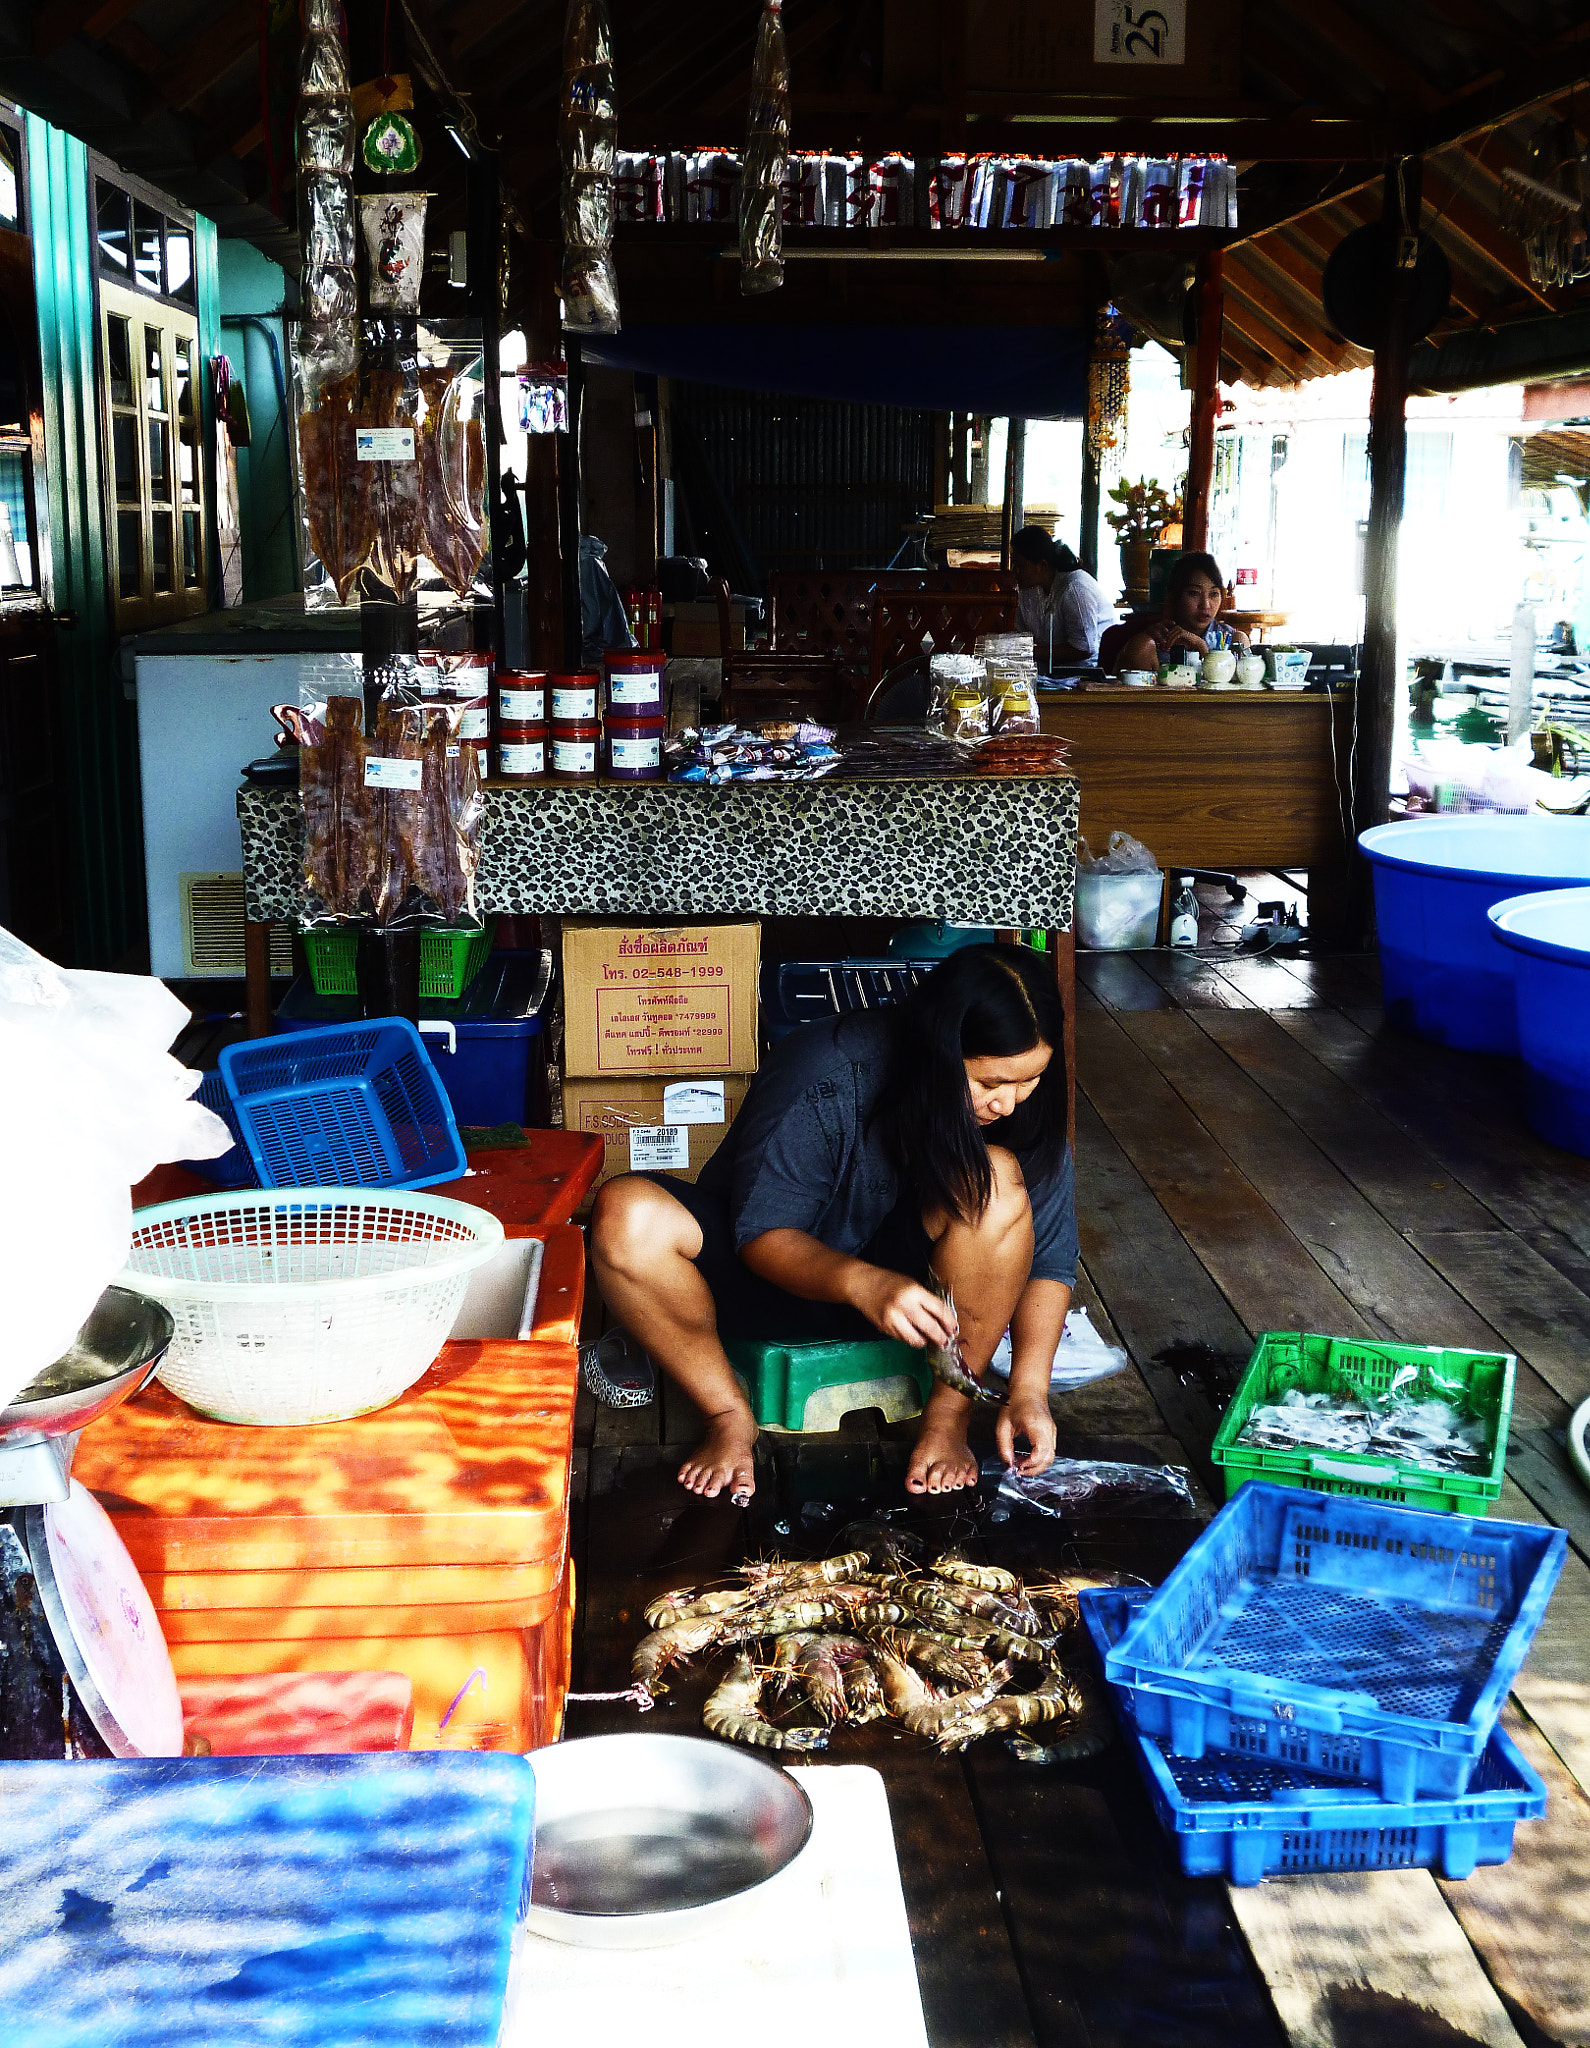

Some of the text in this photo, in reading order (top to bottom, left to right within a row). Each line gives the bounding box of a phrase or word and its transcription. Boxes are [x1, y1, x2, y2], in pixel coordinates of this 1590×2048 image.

[1124, 5, 1169, 58] 25
[618, 935, 709, 955] สั่งซื้อผลิตภัณฑ์
[602, 964, 724, 980] โทร. 02-548-1999
[637, 994, 689, 1006] โทรศัพท์มือถือ
[604, 1029, 627, 1039] ดีแทค
[662, 1042, 703, 1055] ทั่วประเทศ
[656, 1128, 679, 1136] 20189
